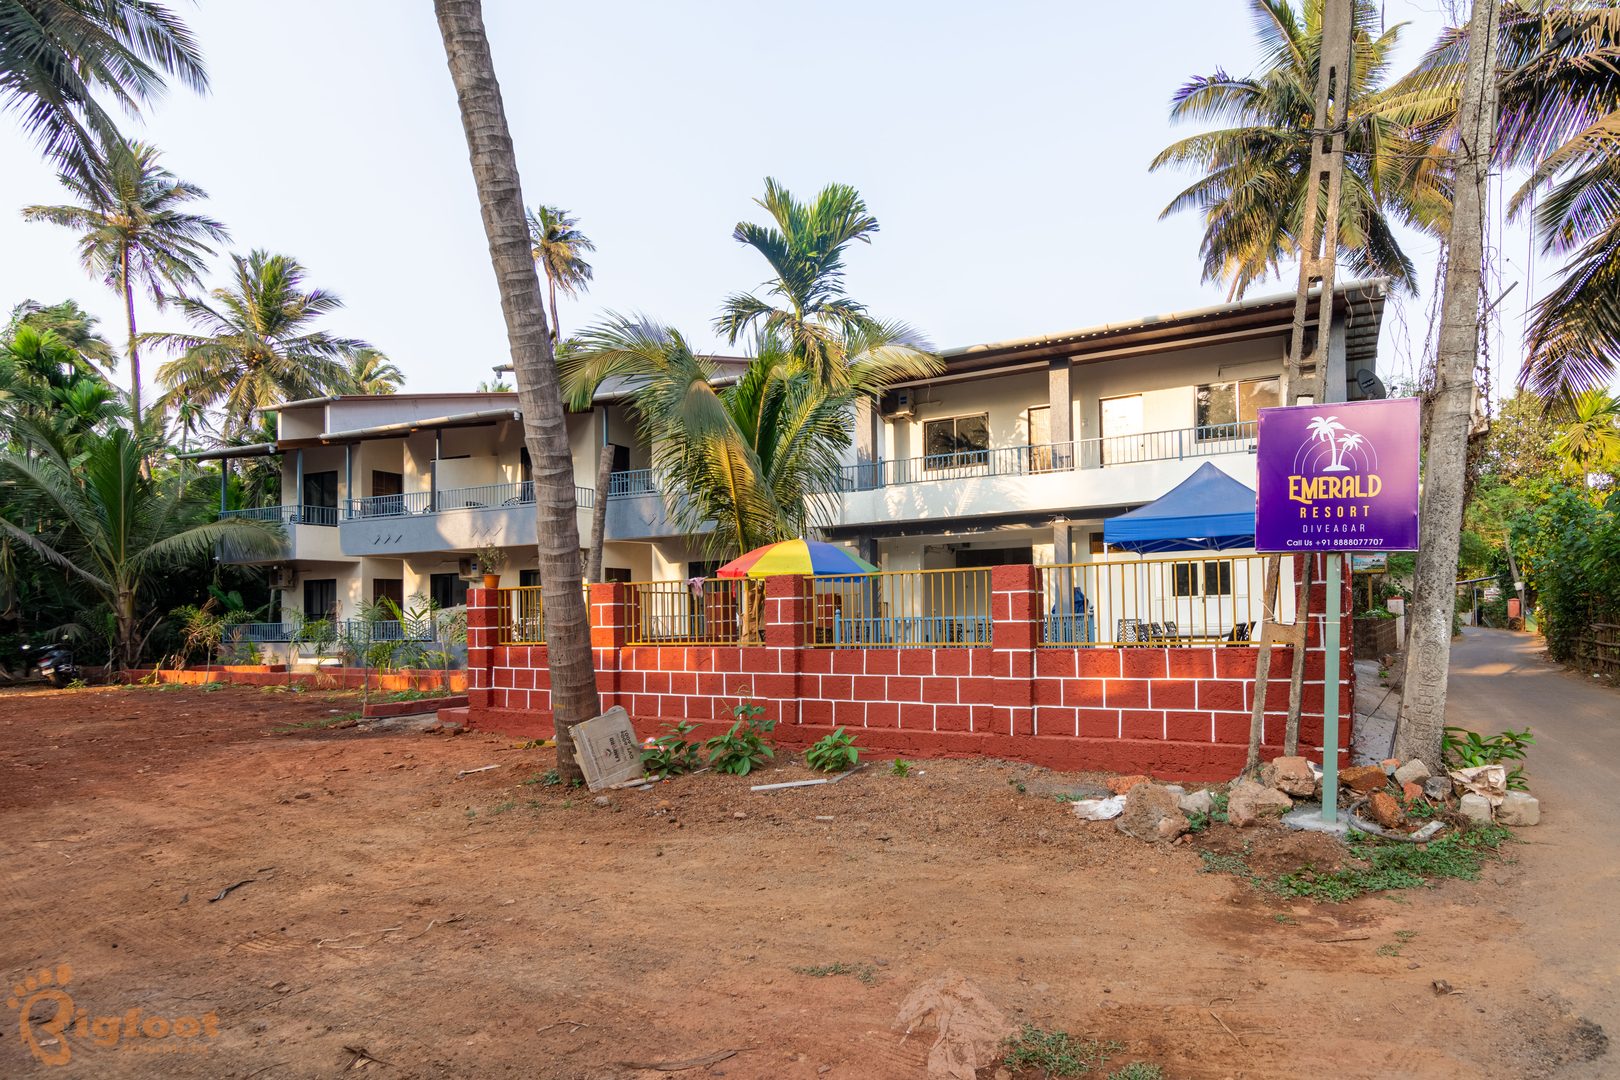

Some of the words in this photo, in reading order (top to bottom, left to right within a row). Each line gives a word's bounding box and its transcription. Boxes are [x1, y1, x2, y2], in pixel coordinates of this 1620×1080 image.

[1288, 474, 1382, 505] EMERALD
[1300, 505, 1370, 518] RESORT
[1302, 523, 1366, 534] DIVEAGAR
[1286, 539, 1303, 547] Call
[1303, 539, 1313, 547] Us
[1315, 539, 1331, 547] +91
[1333, 538, 1384, 546] 8888077707
